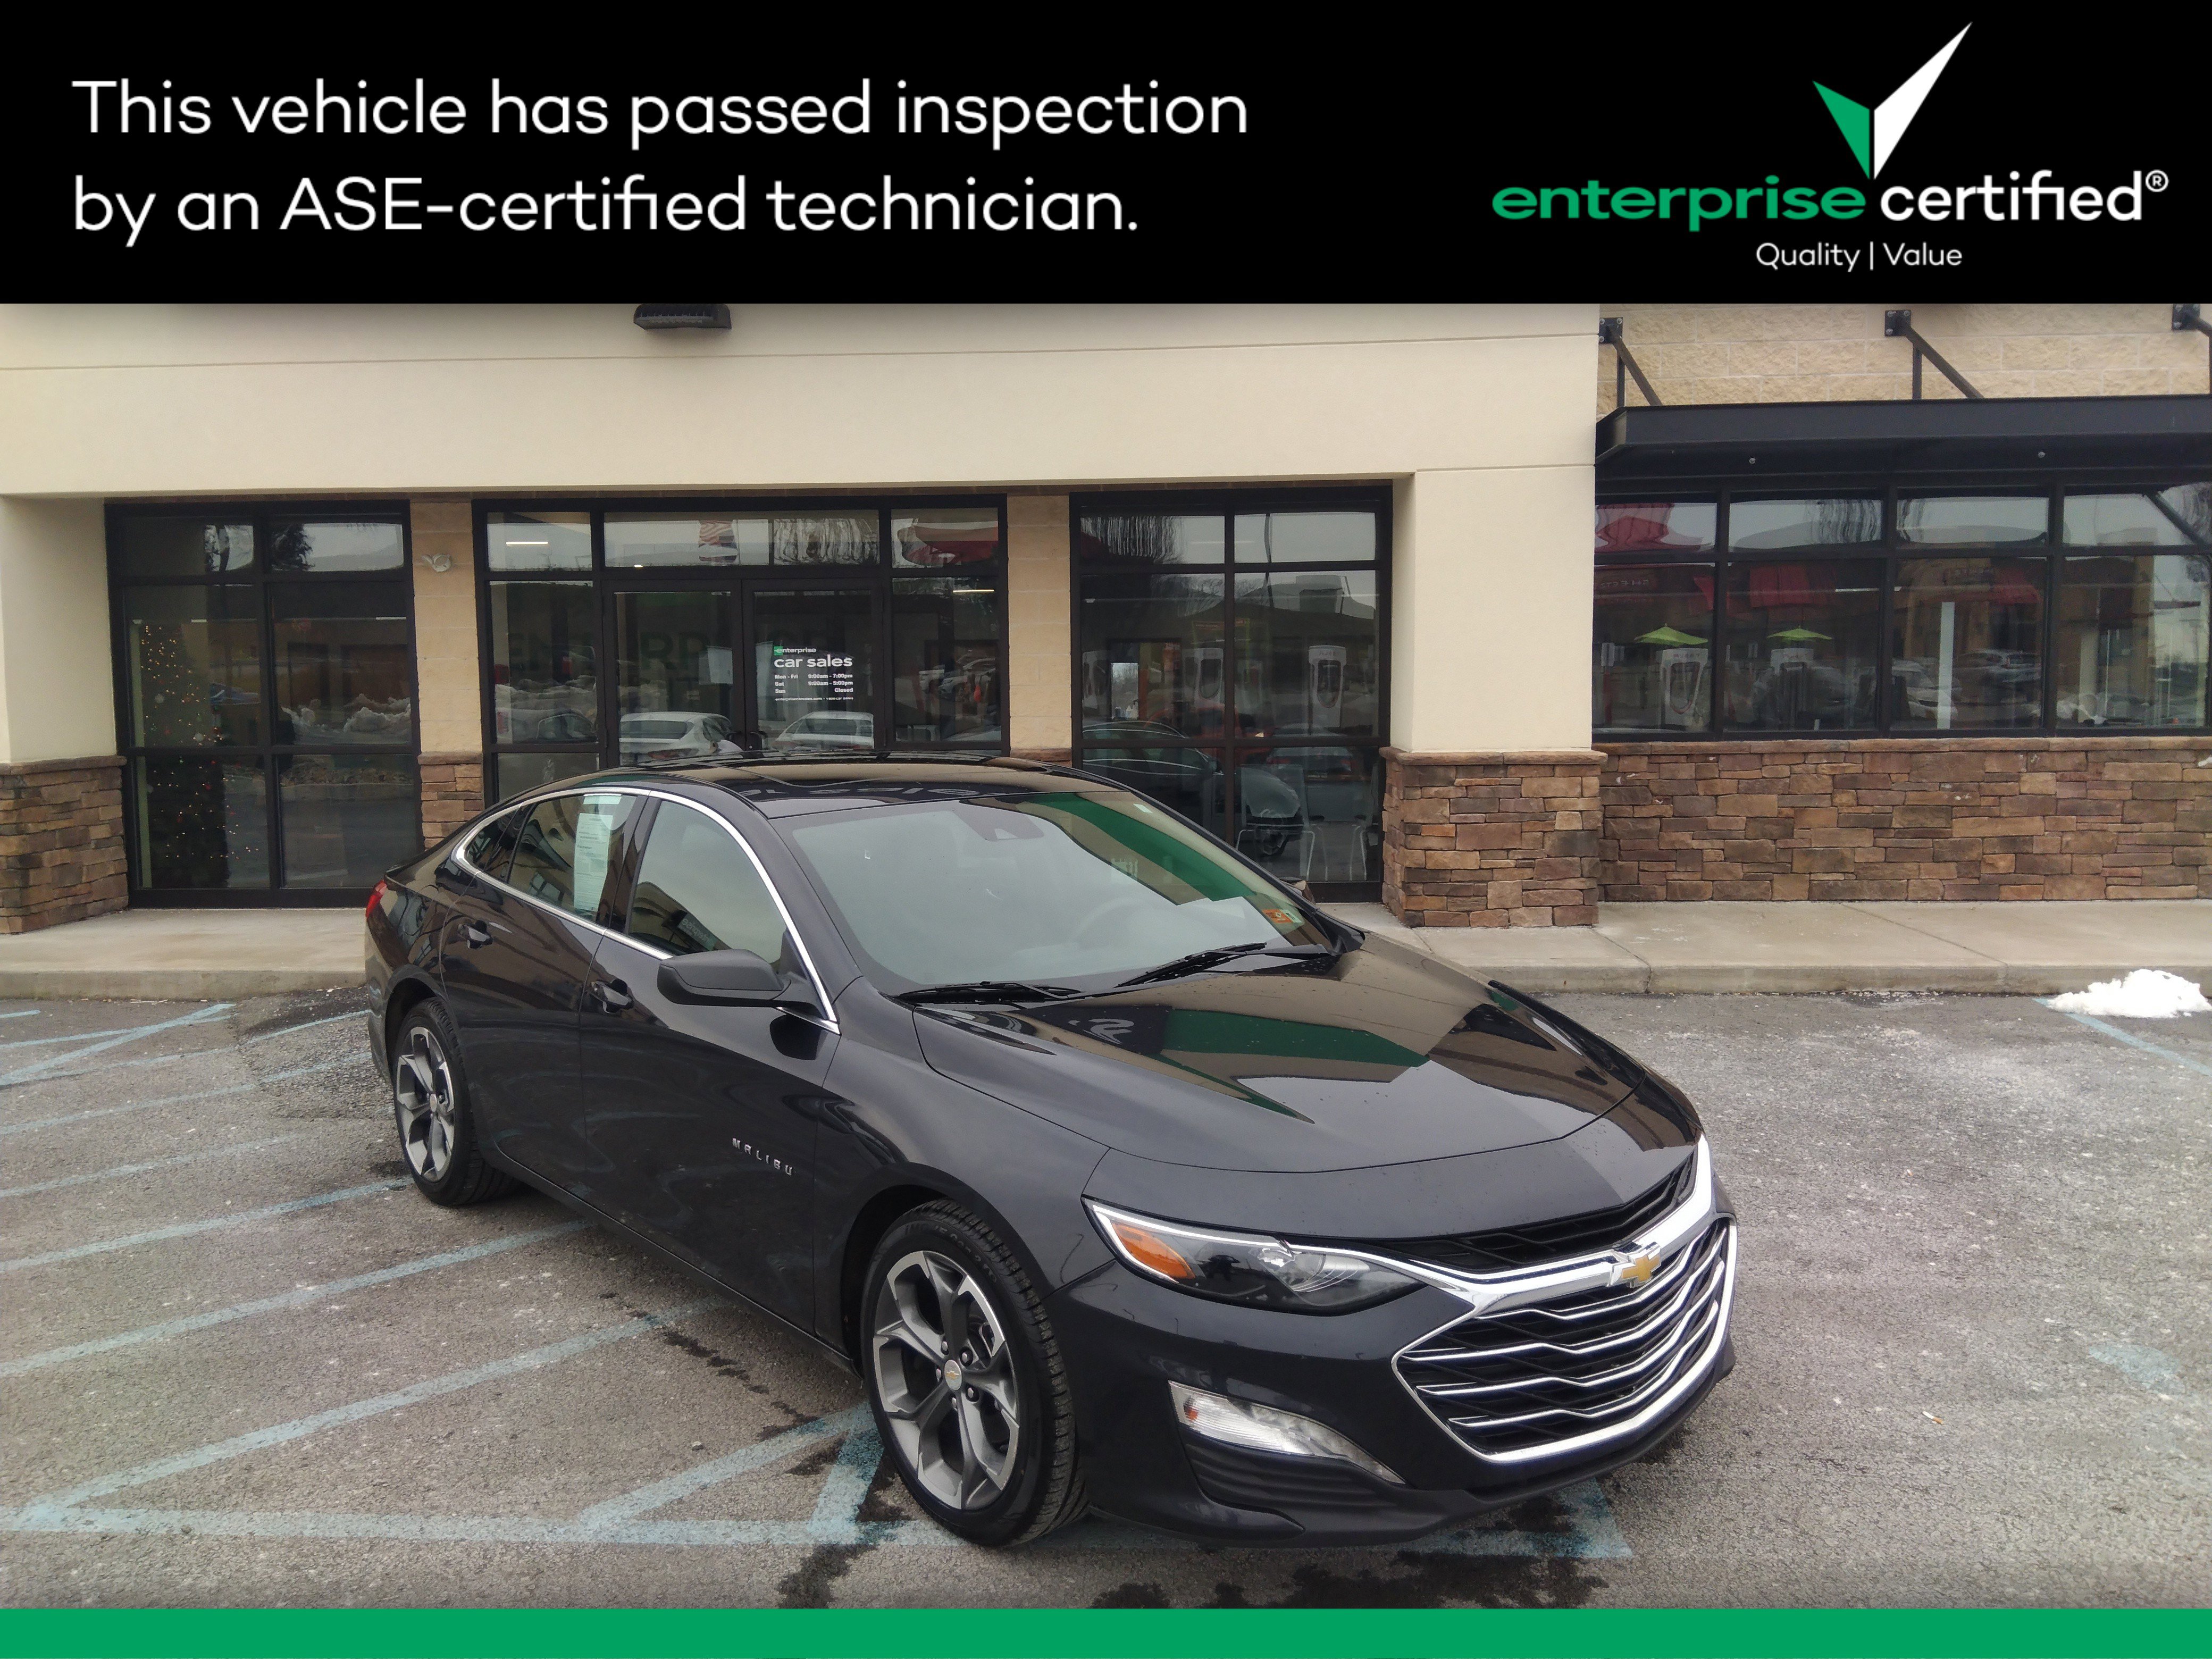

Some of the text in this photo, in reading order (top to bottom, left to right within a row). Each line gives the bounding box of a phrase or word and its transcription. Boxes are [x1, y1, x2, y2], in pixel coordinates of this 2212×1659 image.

[774, 654, 853, 668] car sales
[732, 1138, 792, 1176] MALIBU
